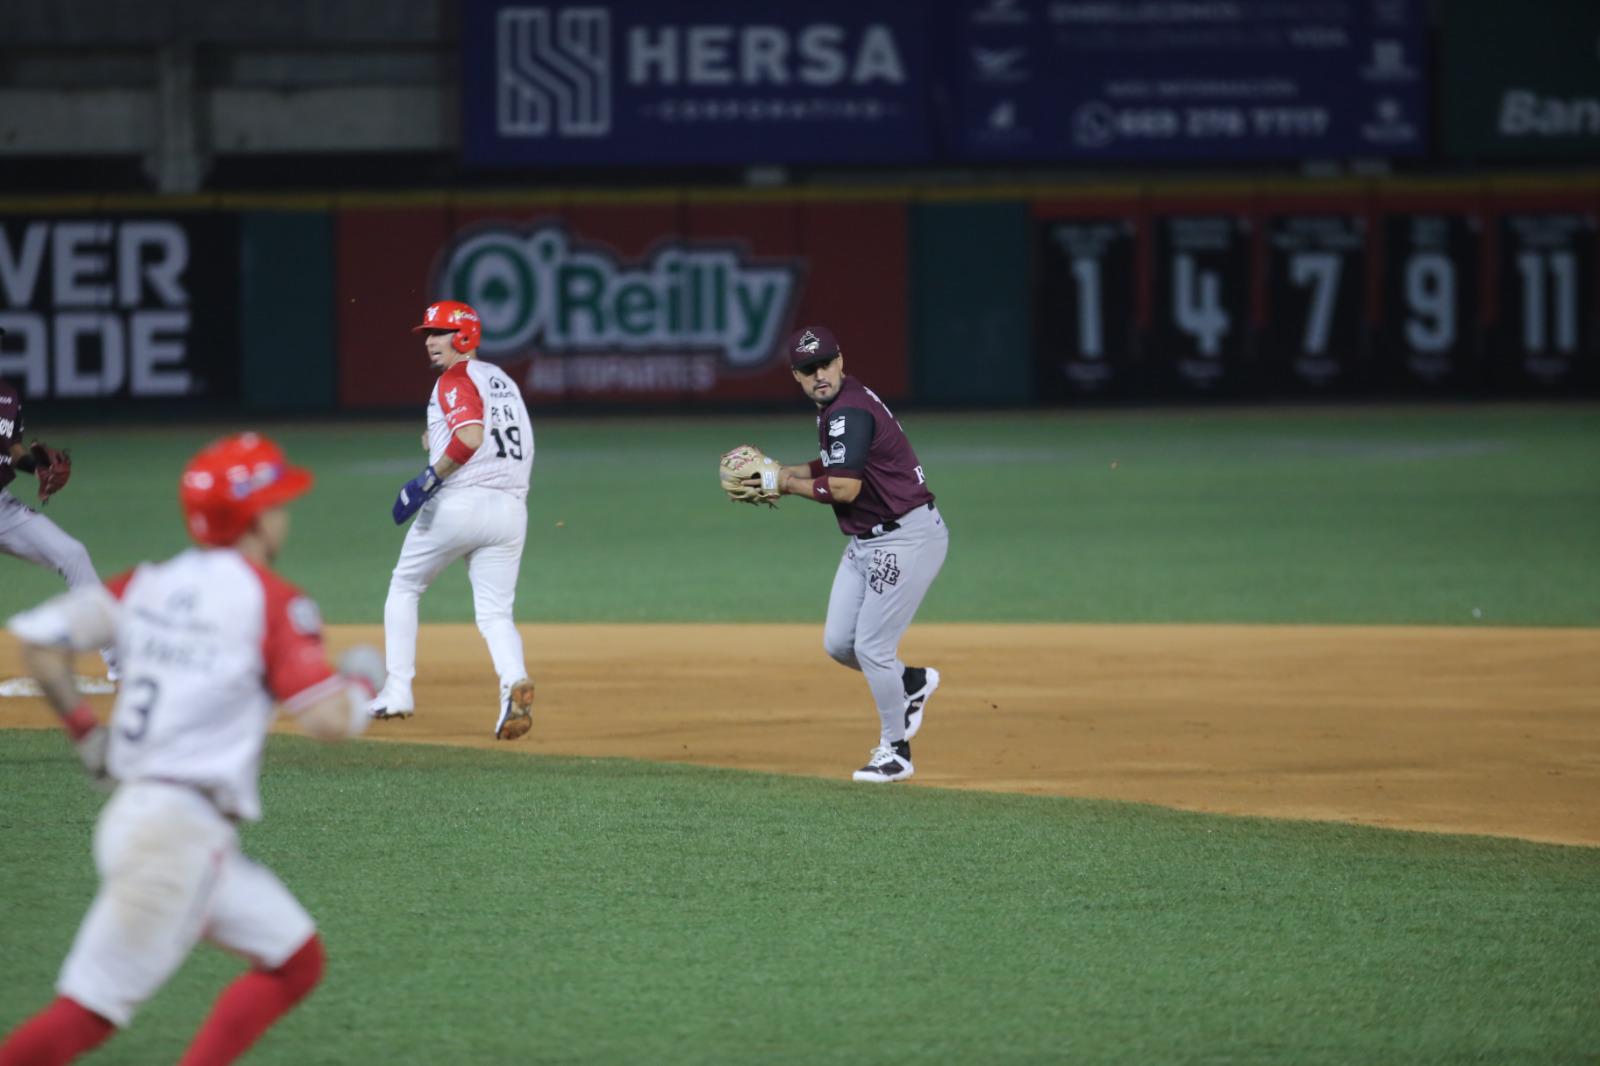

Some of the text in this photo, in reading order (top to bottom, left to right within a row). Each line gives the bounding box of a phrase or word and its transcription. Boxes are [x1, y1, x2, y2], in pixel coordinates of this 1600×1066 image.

[628, 25, 906, 84] HERSA
[443, 231, 793, 360] O'Reilly
[1071, 256, 1102, 358] 1
[1173, 255, 1229, 356] 4
[1290, 254, 1343, 354] 7
[1405, 252, 1457, 352] 9
[1517, 252, 1576, 352] 11
[490, 426, 523, 461] 19
[122, 676, 159, 742] 3
